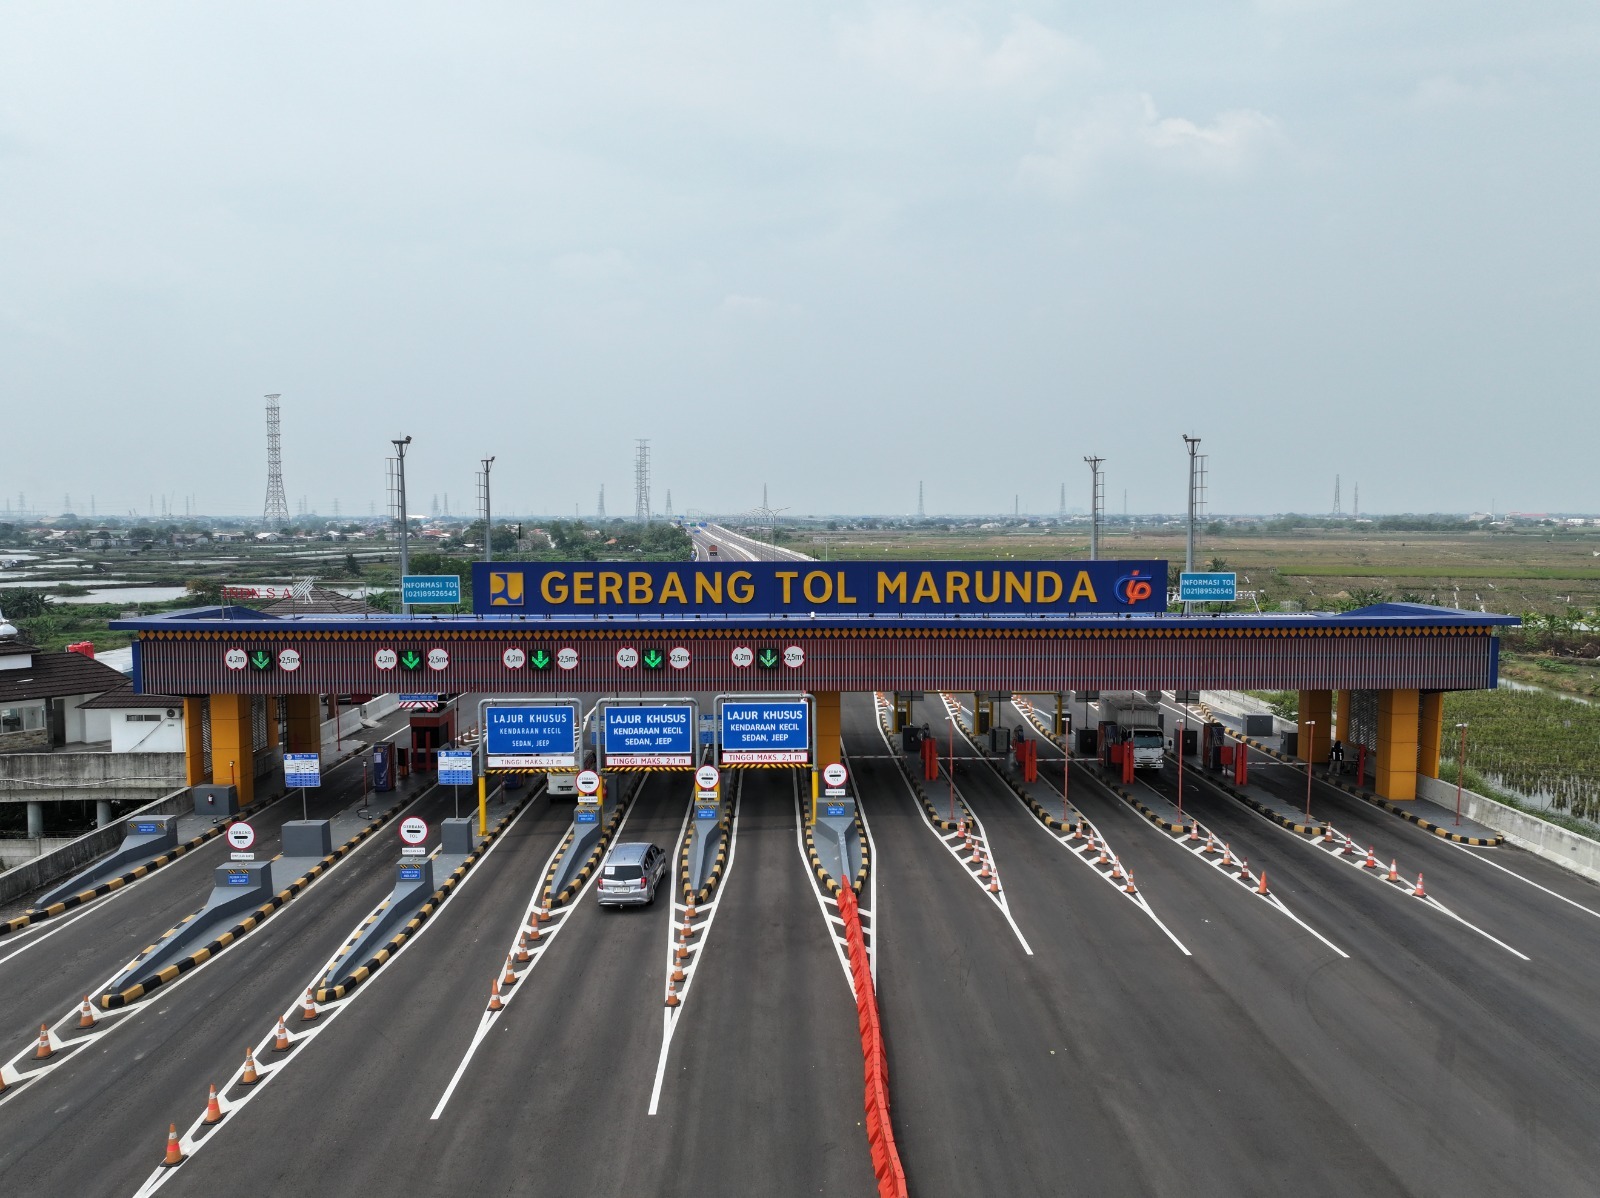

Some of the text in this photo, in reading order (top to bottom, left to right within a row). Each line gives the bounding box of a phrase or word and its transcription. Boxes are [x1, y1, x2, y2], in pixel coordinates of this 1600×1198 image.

[540, 571, 1098, 604] GERBANG TOL MARUNDA
[228, 656, 245, 664] 4,2m
[378, 656, 395, 664] 4,2m
[430, 656, 446, 664] 2,5m
[506, 655, 523, 663] 4,2m
[560, 655, 576, 663] 2,5m
[786, 654, 802, 662] 2,5m
[493, 714, 567, 723] LAJUR KHUSUS
[610, 714, 686, 724] LAJUR KHUSUS
[728, 710, 802, 720] LAJUR KHUSUS
[625, 738, 652, 746] SEDAN,
